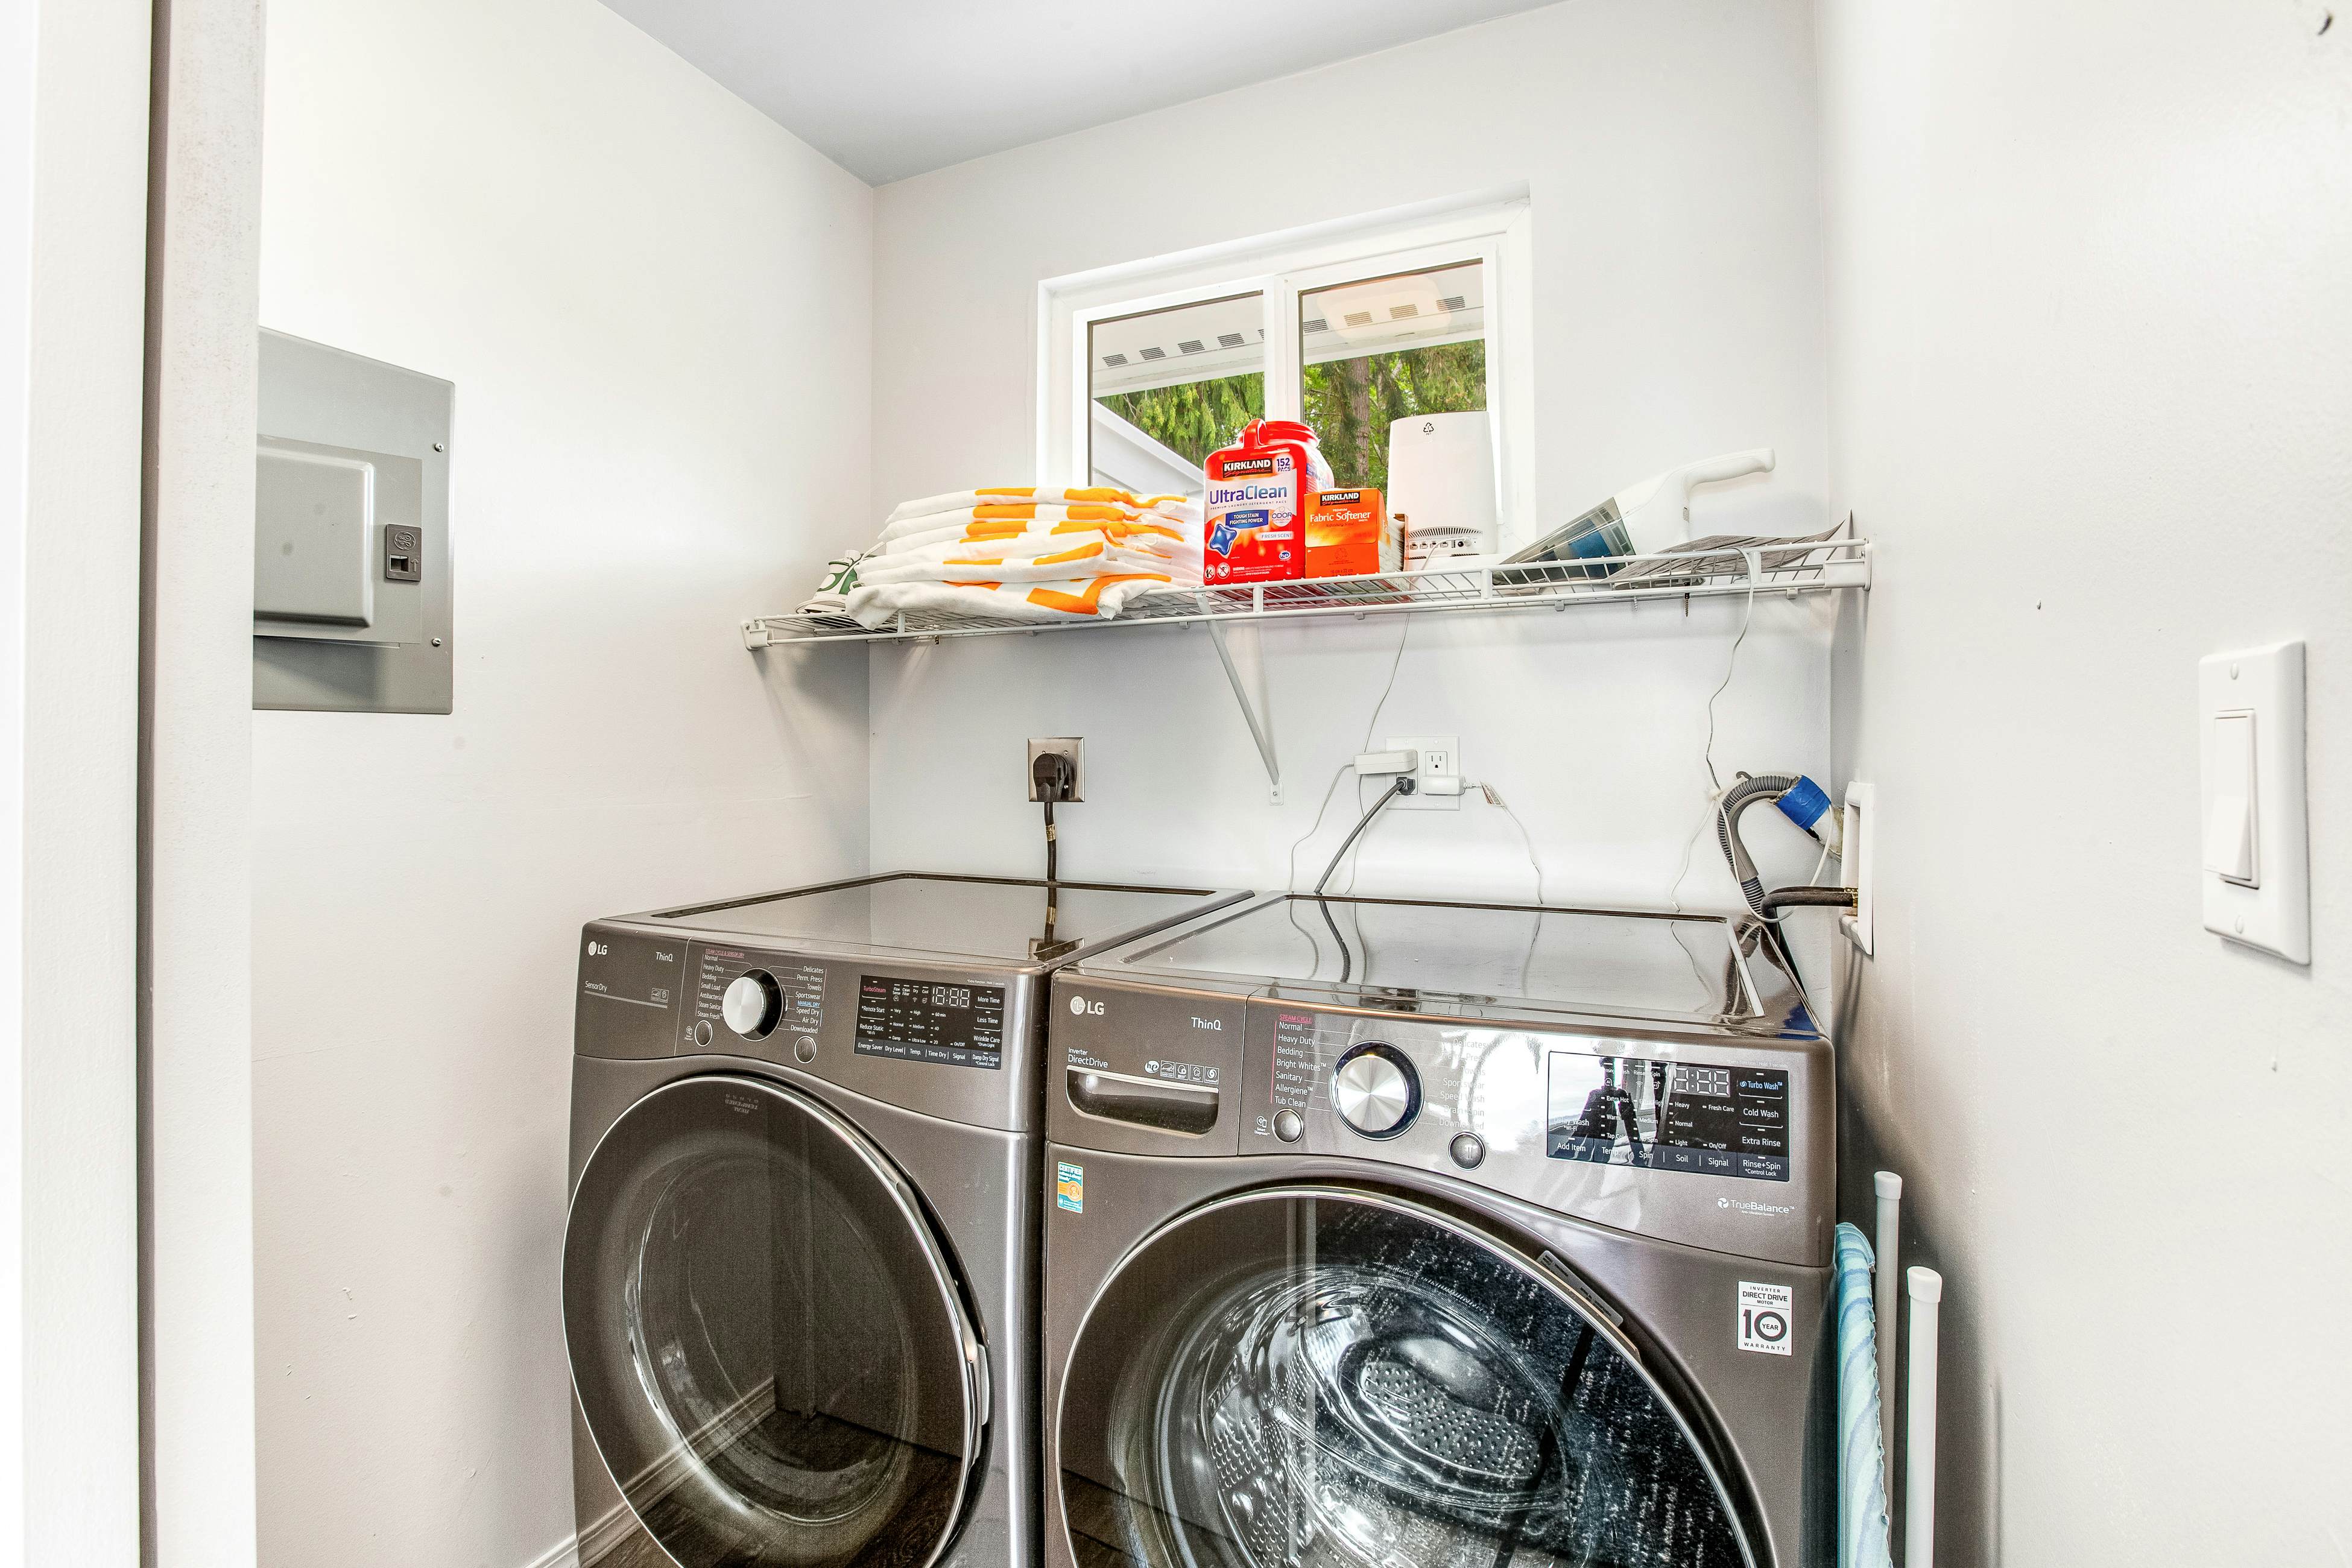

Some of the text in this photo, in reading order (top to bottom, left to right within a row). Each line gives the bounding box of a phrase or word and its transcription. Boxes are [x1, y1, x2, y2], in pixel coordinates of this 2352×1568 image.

[1224, 459, 1271, 472] KIRKLAND
[1277, 458, 1290, 467] 152
[1225, 468, 1271, 477] Signature
[1210, 485, 1287, 504] UltraClean
[1322, 493, 1359, 501] KIRKLAND
[1310, 511, 1371, 522] Fabric Softener
[597, 944, 607, 955] LG
[656, 952, 673, 962] ThinQ
[715, 965, 724, 973] Duty
[702, 973, 716, 982] Bedding
[700, 992, 723, 1001] Antibacterial
[795, 991, 821, 1000] Sportswear
[709, 1003, 722, 1011] Sanitary
[1087, 1001, 1105, 1016] LG
[1191, 1016, 1222, 1031] ThinQ
[1279, 1021, 1302, 1031] Normal
[791, 1025, 818, 1034] Downloaded
[1278, 1033, 1315, 1047] Heavy Duty
[1453, 1038, 1487, 1049] Delicates
[1068, 1047, 1088, 1056] Inverter
[1277, 1046, 1303, 1058] Bedding
[1068, 1054, 1108, 1069] DirectDrive
[1276, 1058, 1297, 1069] Bright
[1461, 1066, 1485, 1075] Towels
[1276, 1071, 1303, 1083] Sanitary
[1443, 1078, 1484, 1089] Sportswear
[1274, 1095, 1306, 1108] Tub Clean
[1440, 1091, 1485, 1103] Speed Wash
[1743, 1108, 1779, 1118] Cold Wash
[1439, 1119, 1485, 1130] Downloaded
[1742, 1136, 1781, 1147] Extra Rinse
[1572, 1143, 1586, 1152] Item
[1602, 1146, 1620, 1156] Temp.
[1639, 1151, 1654, 1160] Spin
[1675, 1154, 1689, 1163] Soil
[1708, 1157, 1729, 1167] Signal
[1743, 1159, 1781, 1171] Rinse+Spin
[1742, 1291, 1788, 1302] DIRECT DRIVE
[1743, 1309, 1788, 1342] 10
[1744, 1342, 1786, 1351] WARRANTY
